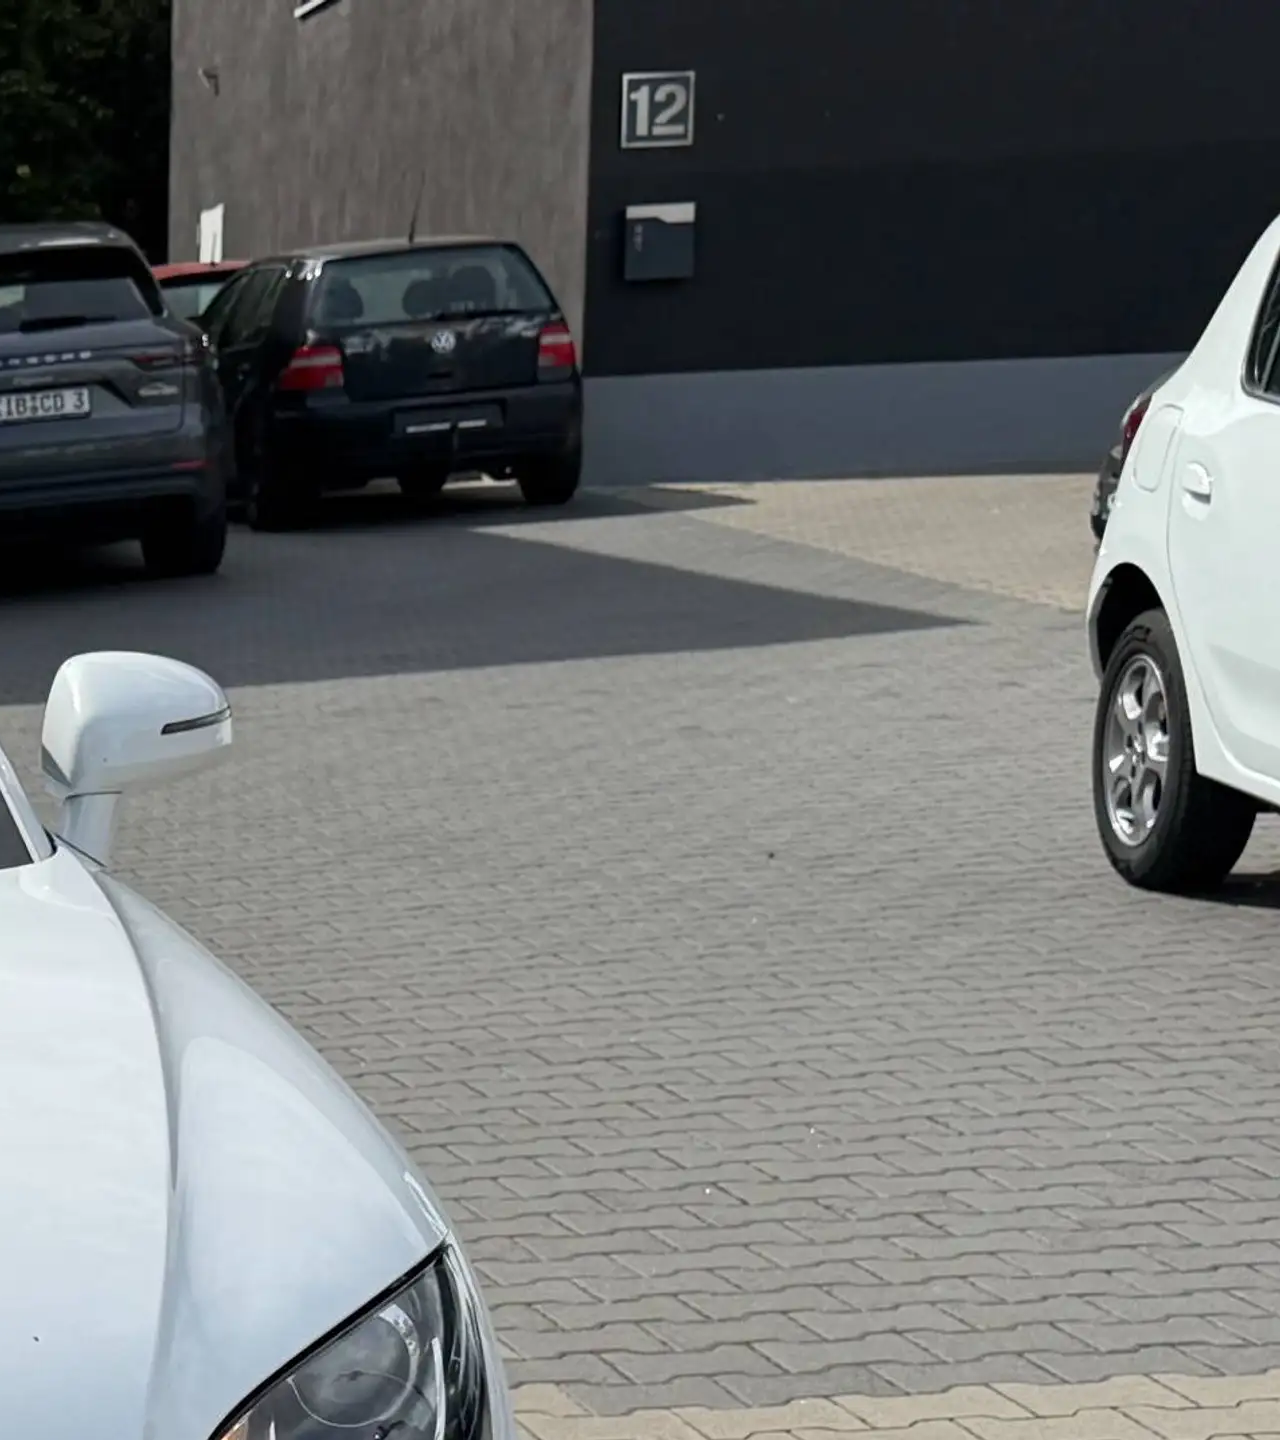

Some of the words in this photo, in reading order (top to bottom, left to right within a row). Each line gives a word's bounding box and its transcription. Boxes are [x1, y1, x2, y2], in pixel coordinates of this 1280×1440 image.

[630, 84, 687, 136] 12
[40, 394, 65, 413] CD
[74, 391, 85, 411] 3
